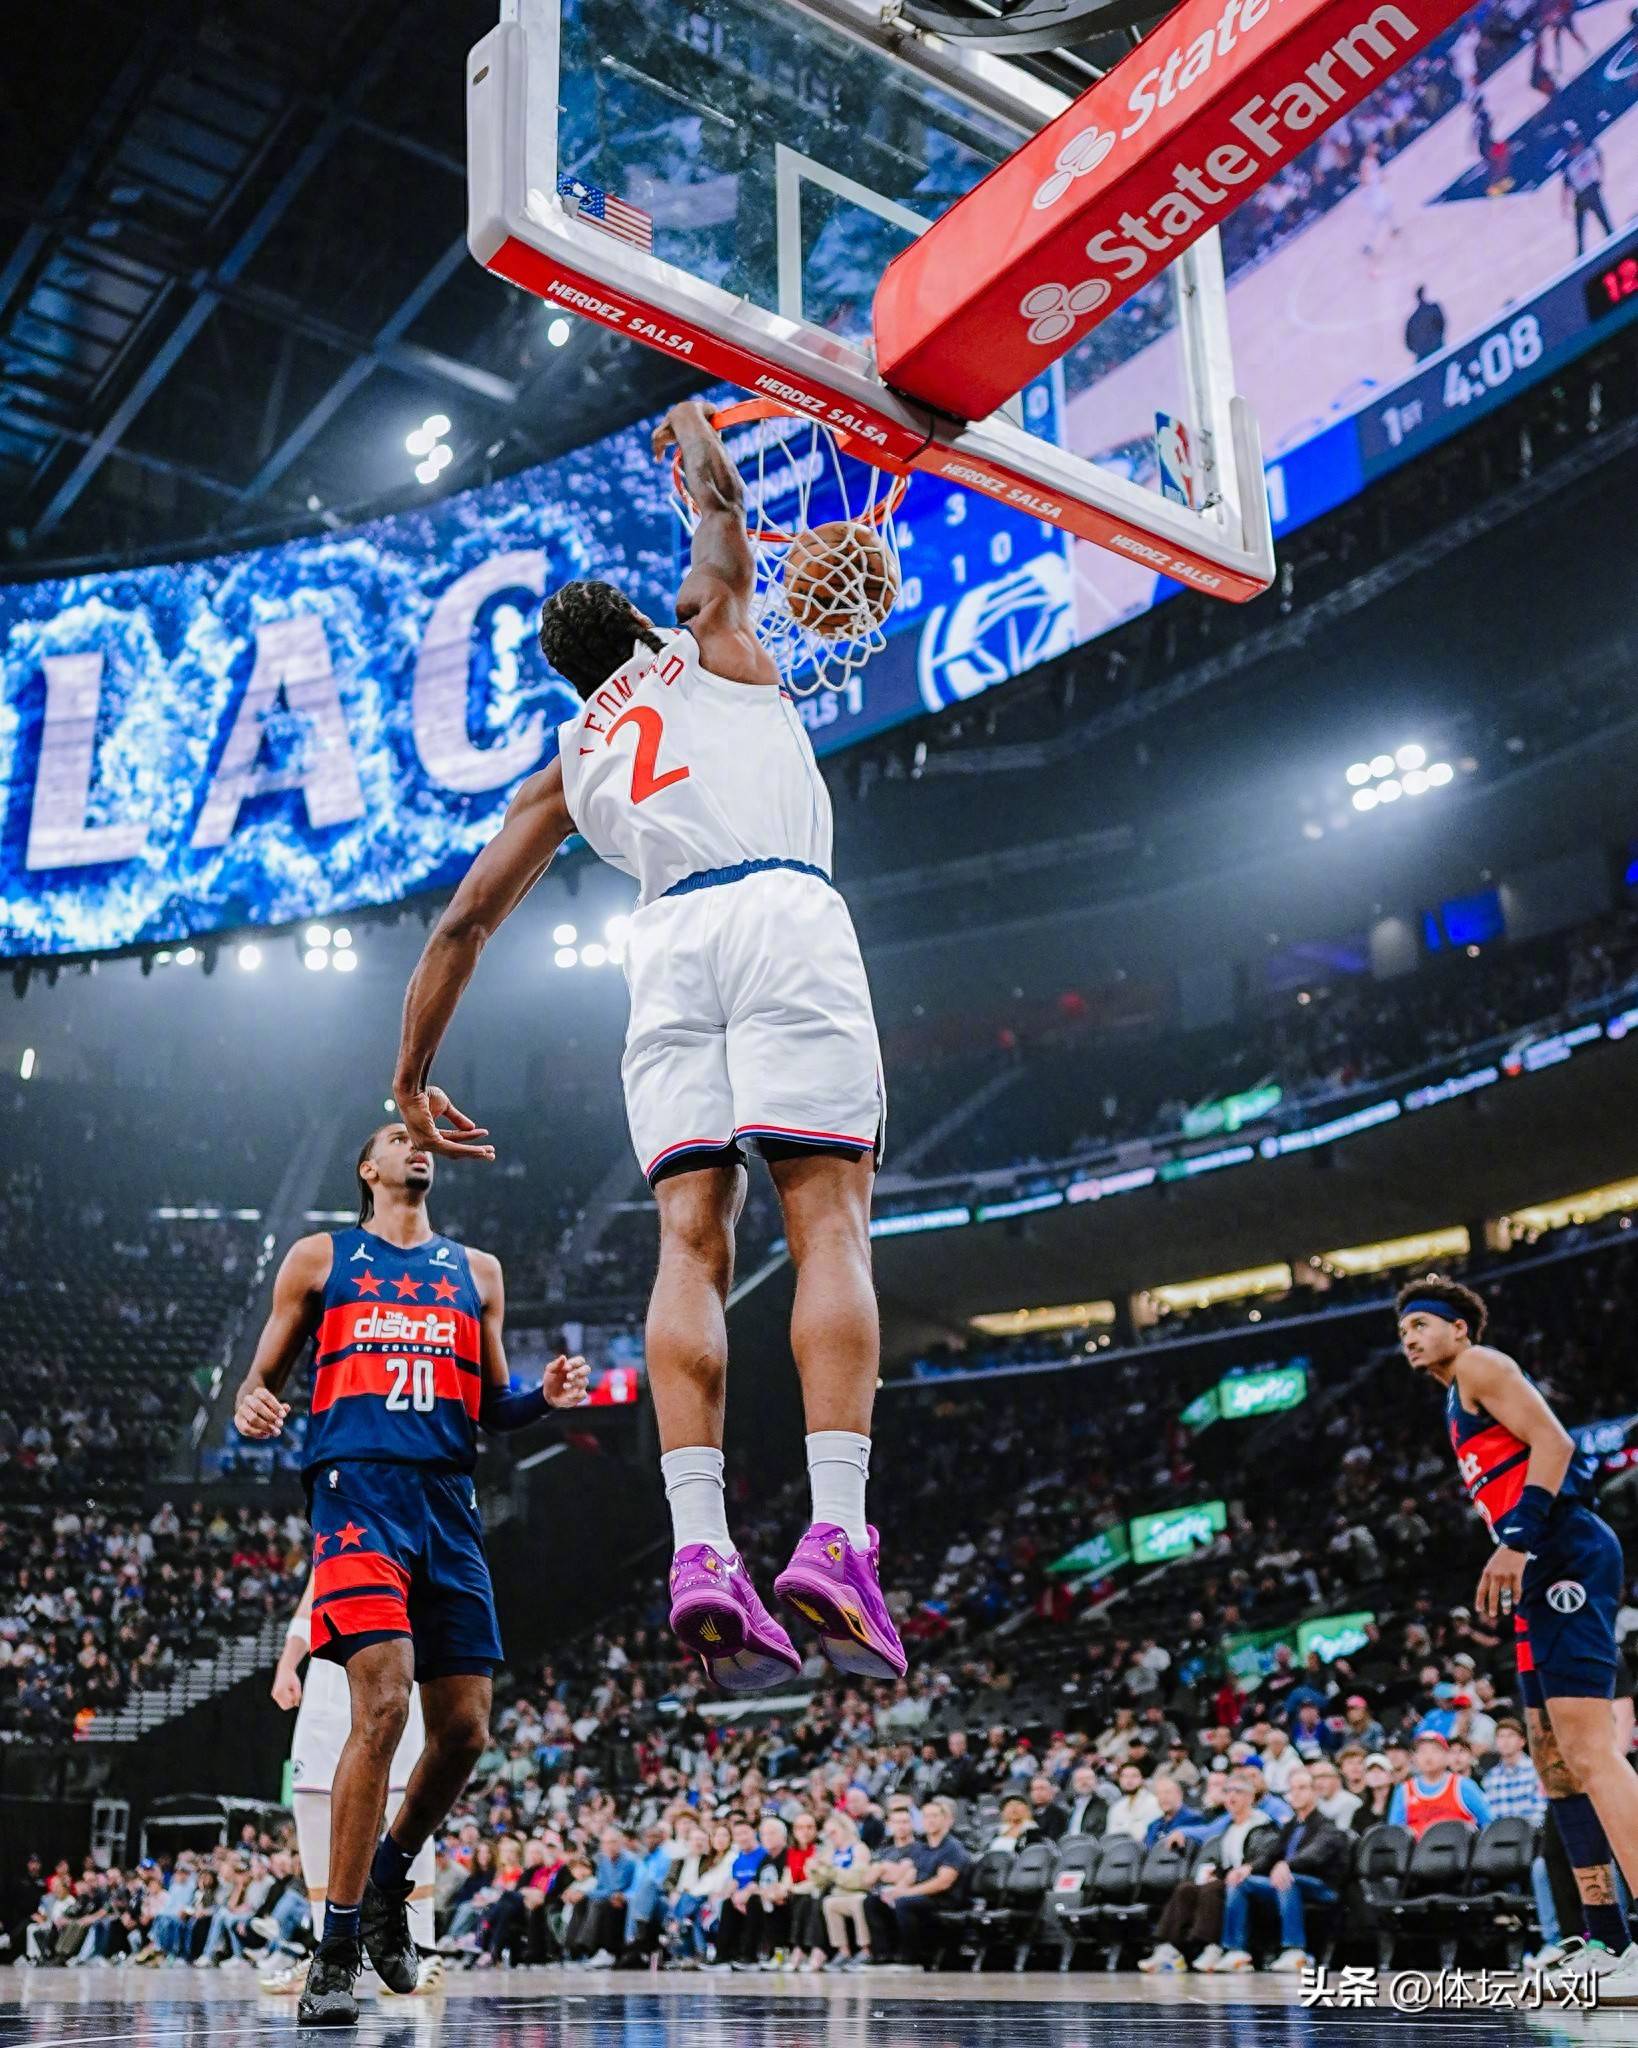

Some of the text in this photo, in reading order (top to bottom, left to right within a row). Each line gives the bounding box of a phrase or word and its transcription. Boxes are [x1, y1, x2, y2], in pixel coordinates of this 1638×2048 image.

[1121, 0, 1284, 140] State
[1085, 4, 1420, 280] StateFarm
[546, 280, 694, 354] HERDEZ SALSA
[1443, 314, 1543, 408] 4:08
[754, 374, 888, 447] HERDEZ SALSA
[940, 462, 1063, 519] HERDEZ SALSA
[1110, 534, 1222, 588] HERDEZ SALSA
[25, 550, 549, 872] LAC
[605, 706, 690, 805] 2
[353, 1306, 456, 1344] district
[355, 1343, 451, 1355] OF COLUMBI
[385, 1358, 435, 1413] 20
